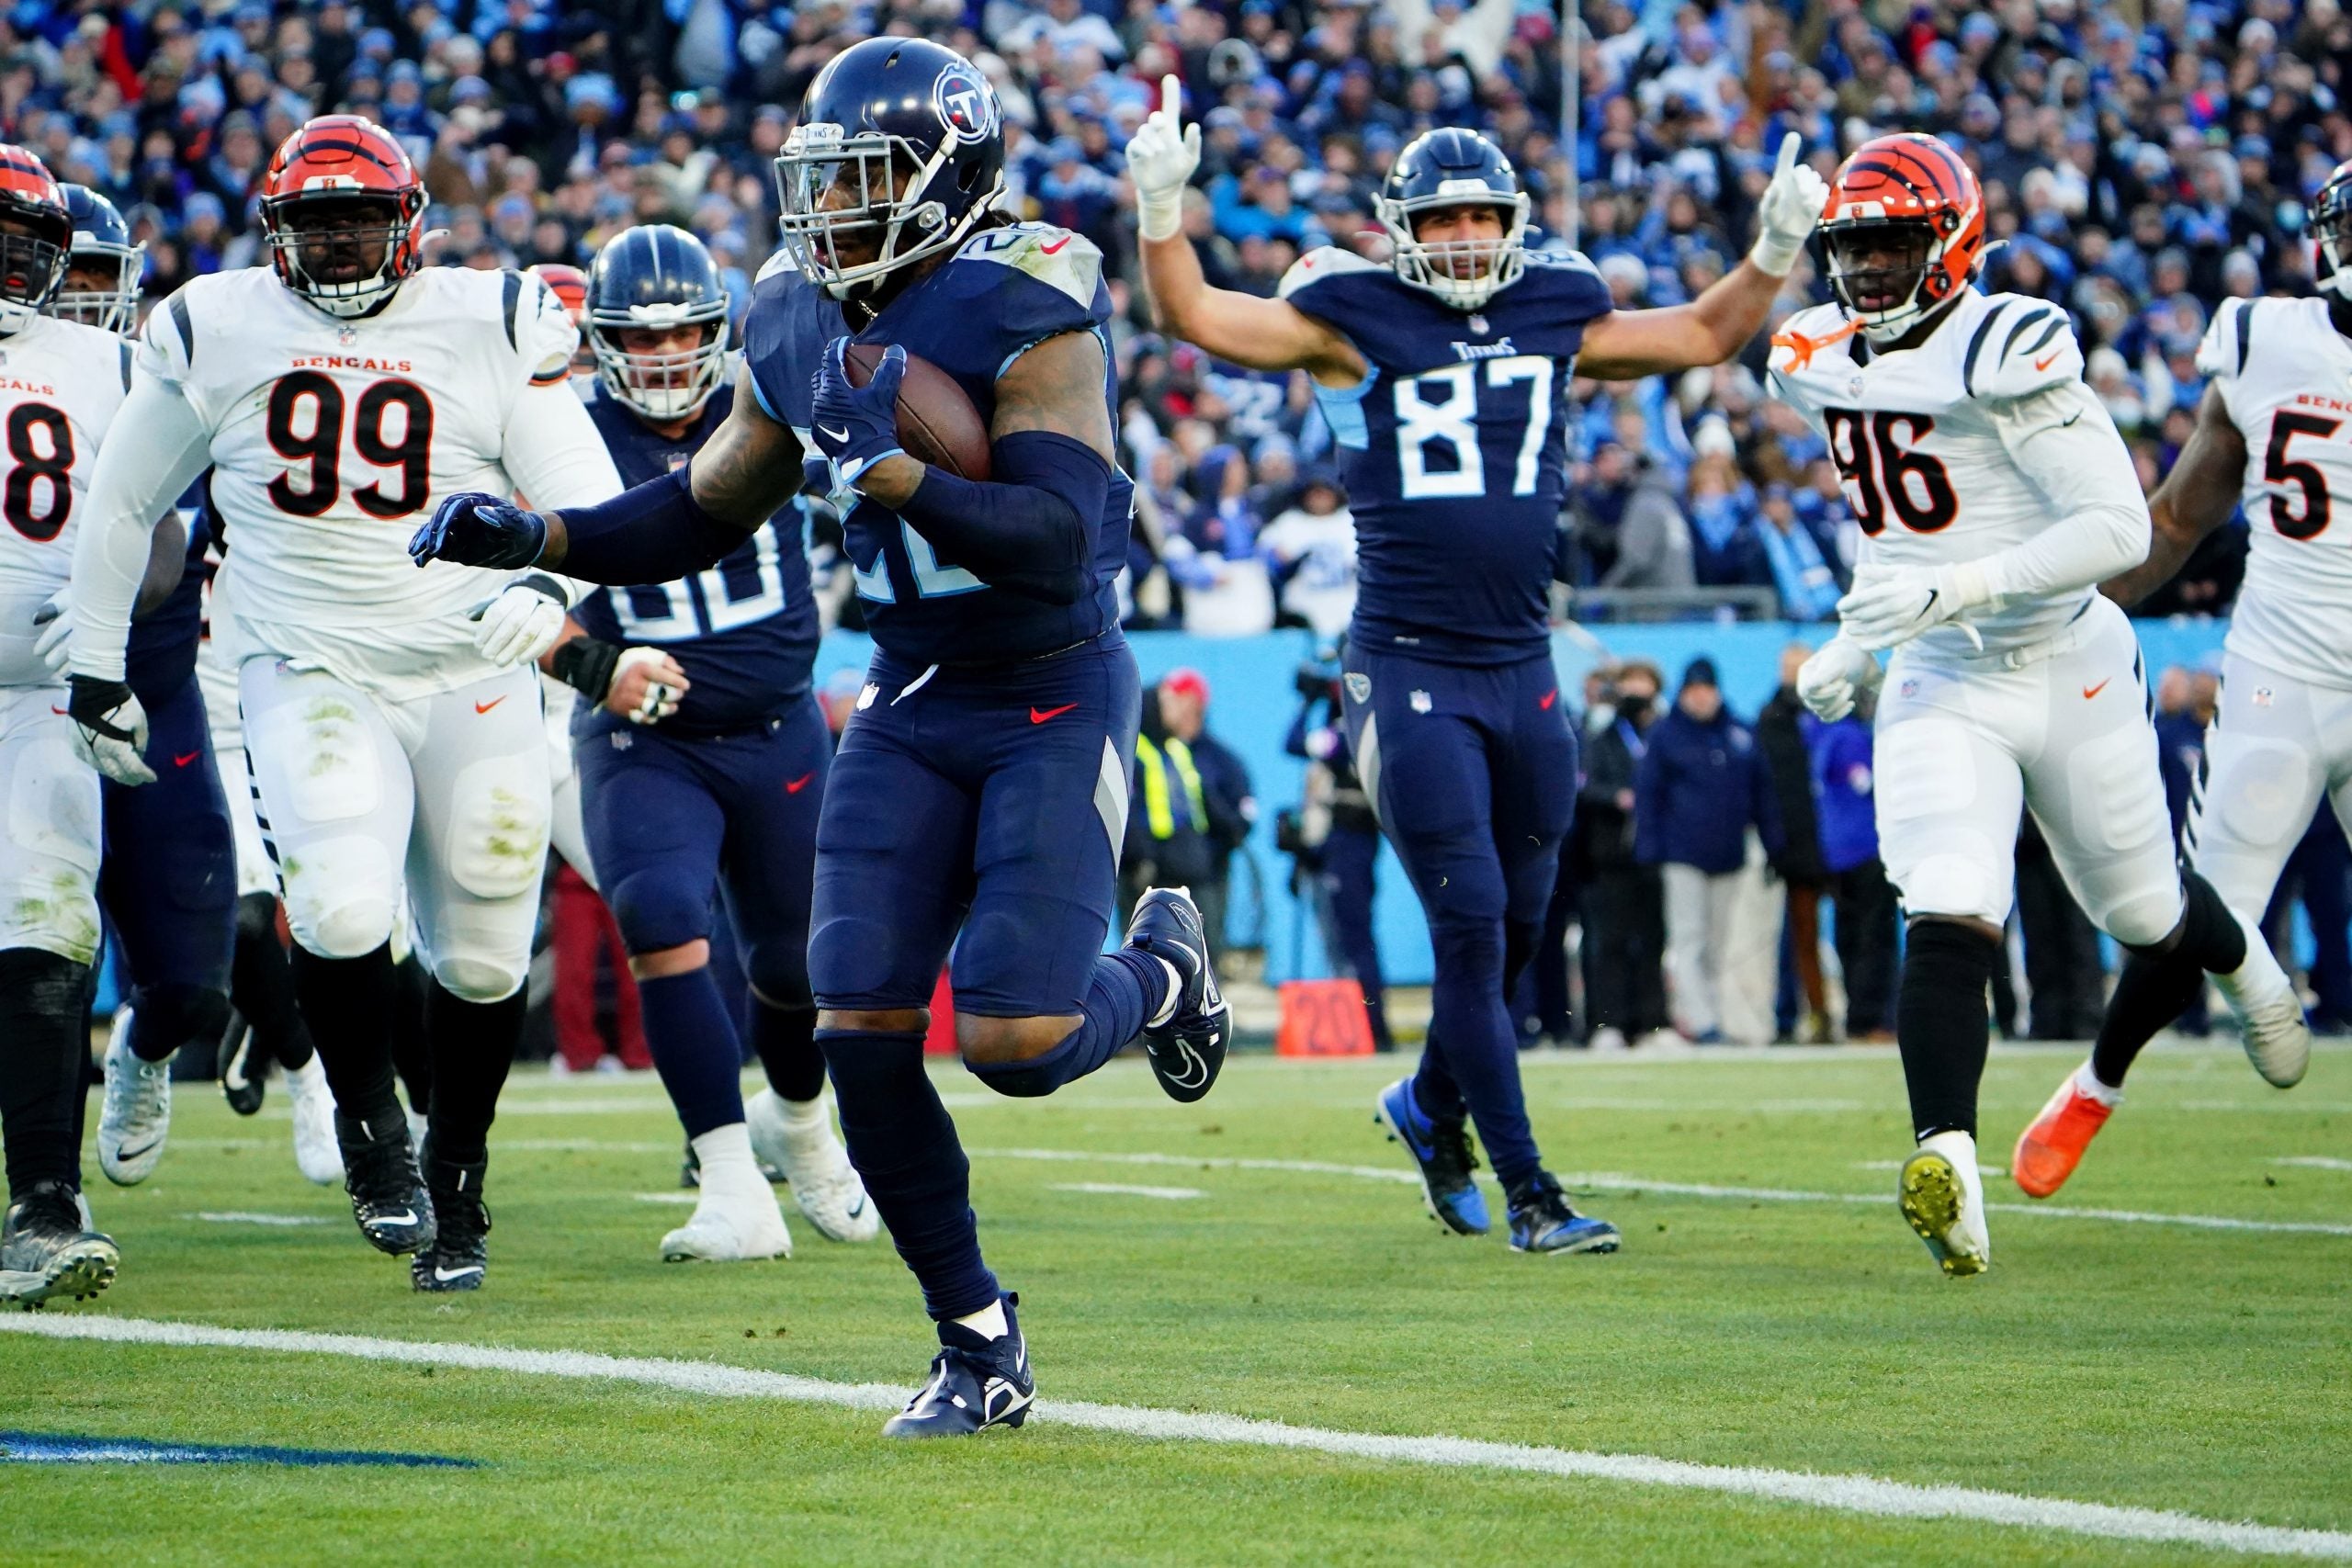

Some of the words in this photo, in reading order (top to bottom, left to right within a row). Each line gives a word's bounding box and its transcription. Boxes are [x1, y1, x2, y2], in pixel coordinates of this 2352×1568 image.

[291, 356, 412, 372] BENGALS
[1392, 355, 1555, 501] 87
[266, 369, 435, 520] 99
[1823, 406, 1961, 538] 96
[1295, 990, 1360, 1055] 20
